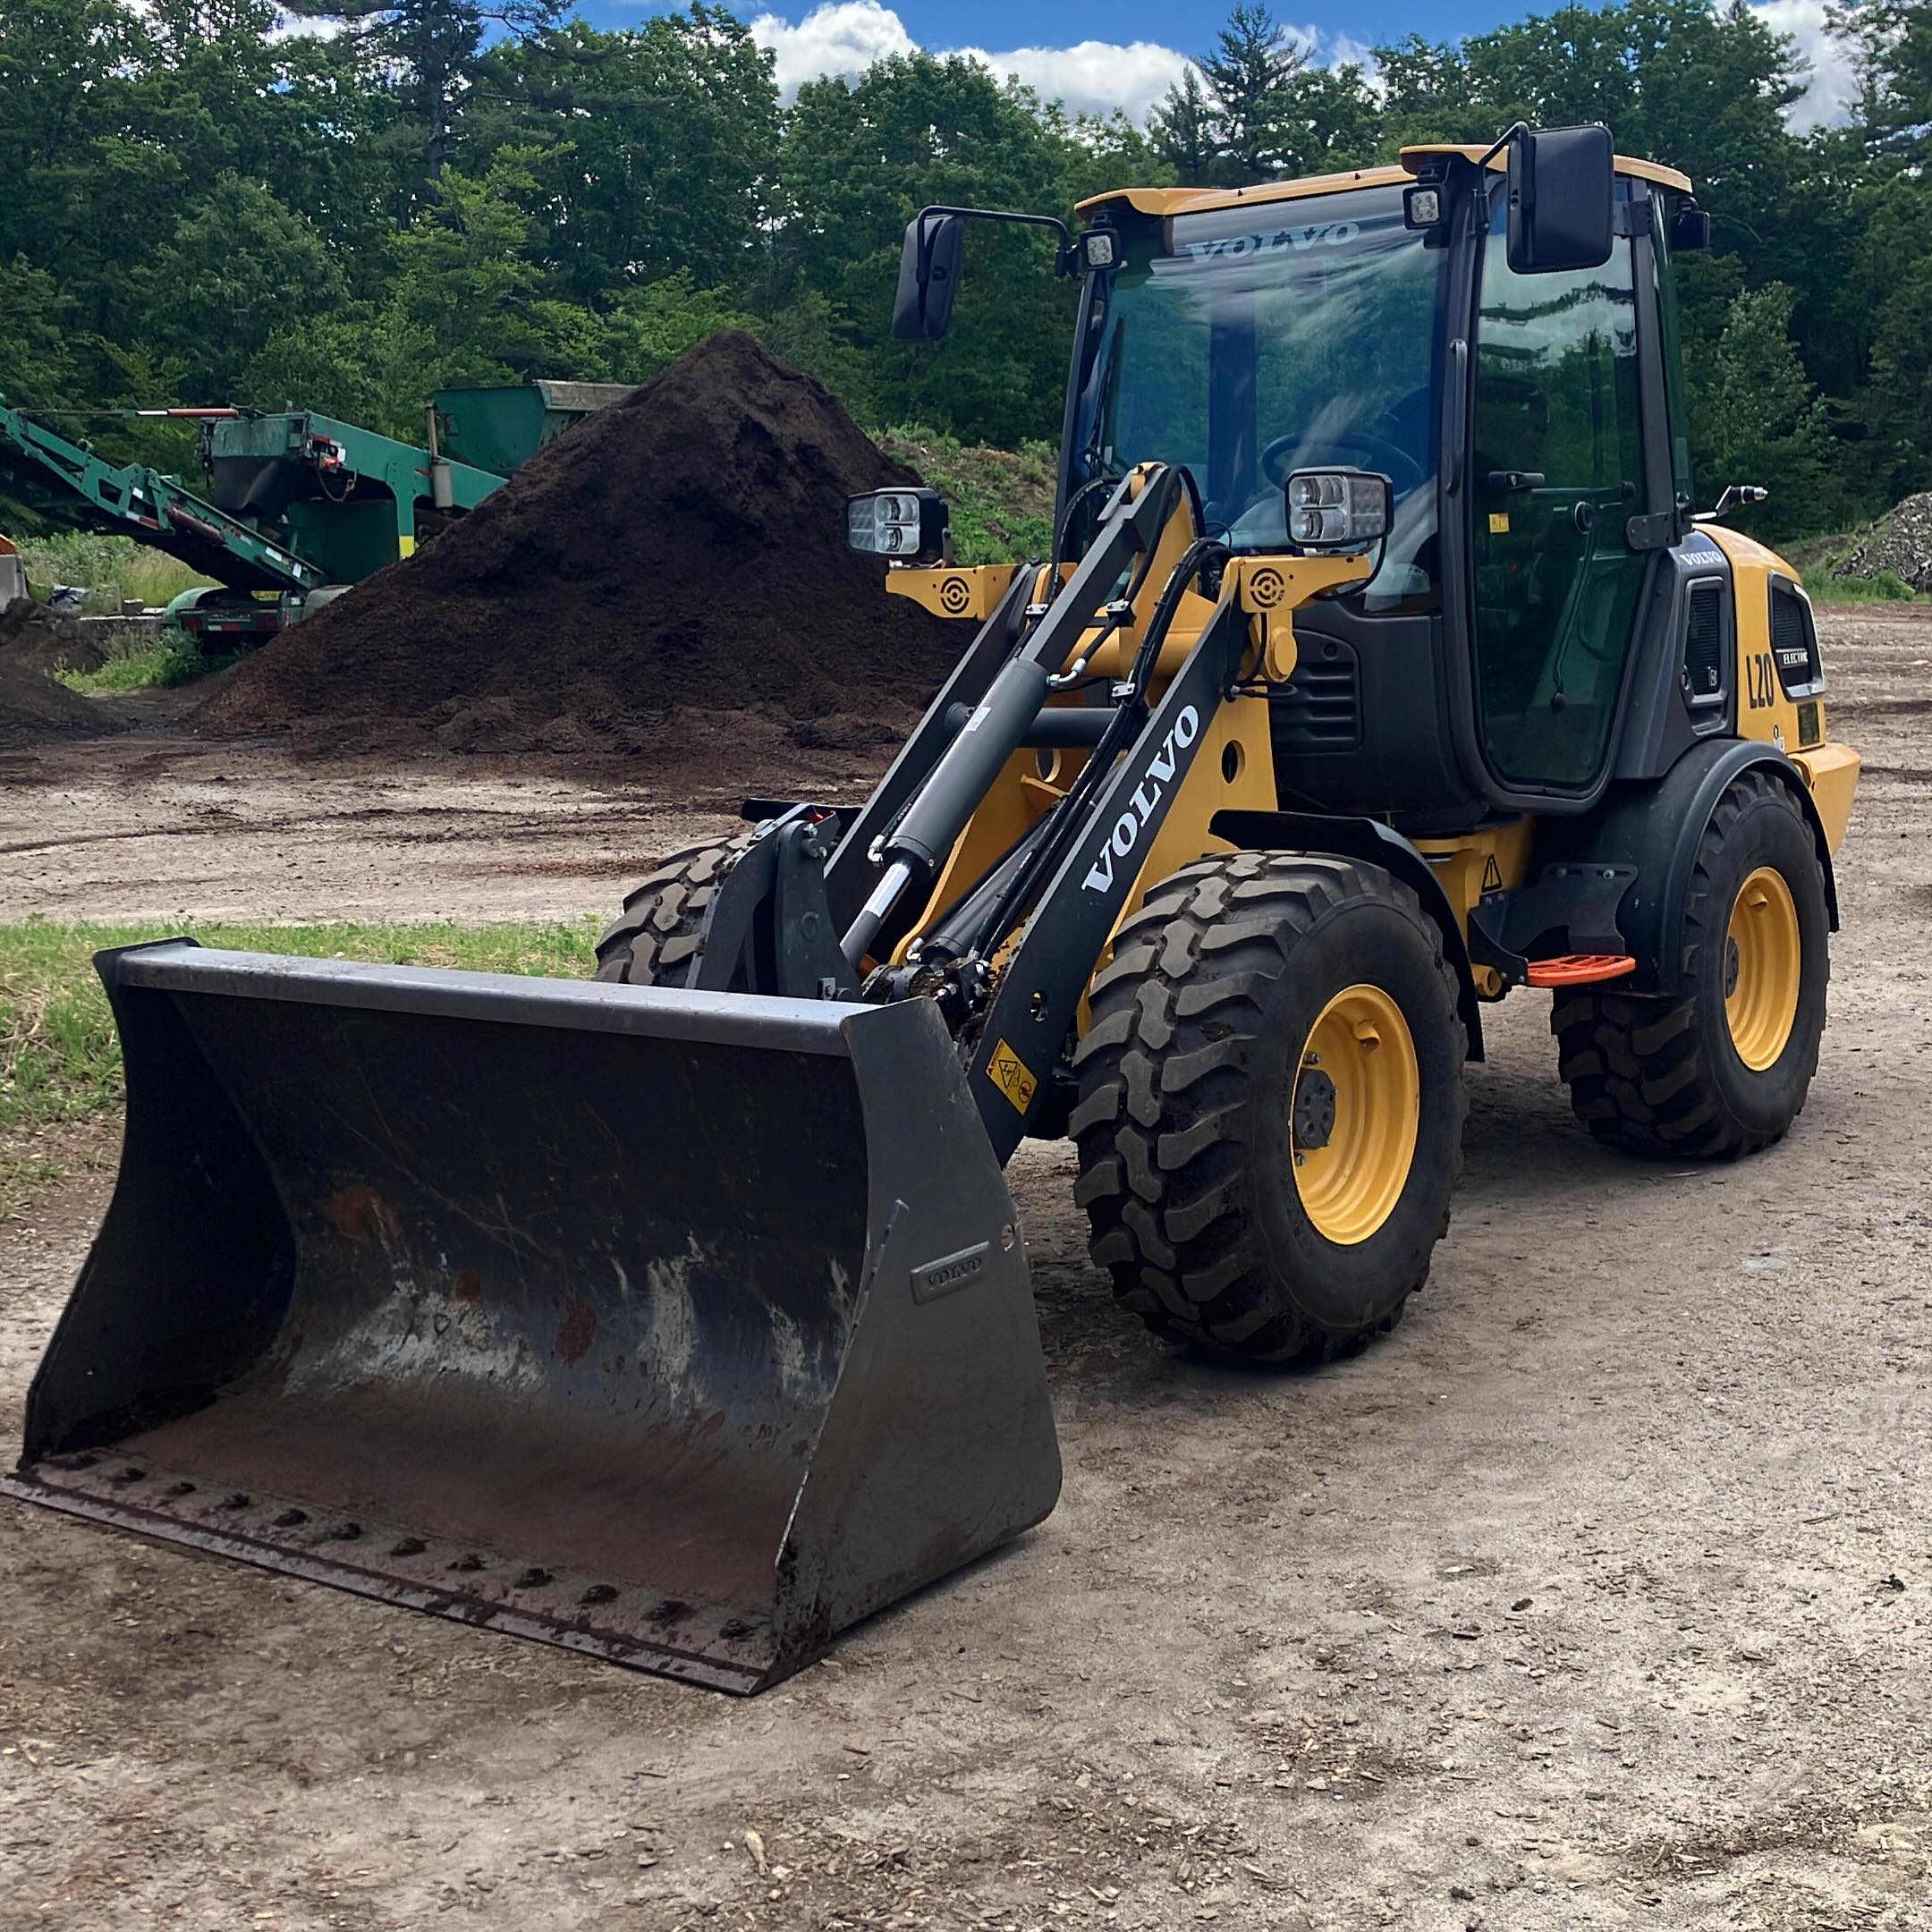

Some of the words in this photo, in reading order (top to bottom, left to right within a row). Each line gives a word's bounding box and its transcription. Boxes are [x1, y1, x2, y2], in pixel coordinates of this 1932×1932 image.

[1186, 222, 1360, 263] VOLVO
[1679, 550, 1724, 565] VOLVO
[1746, 653, 1774, 708] L20
[1081, 705, 1199, 893] VOLVO
